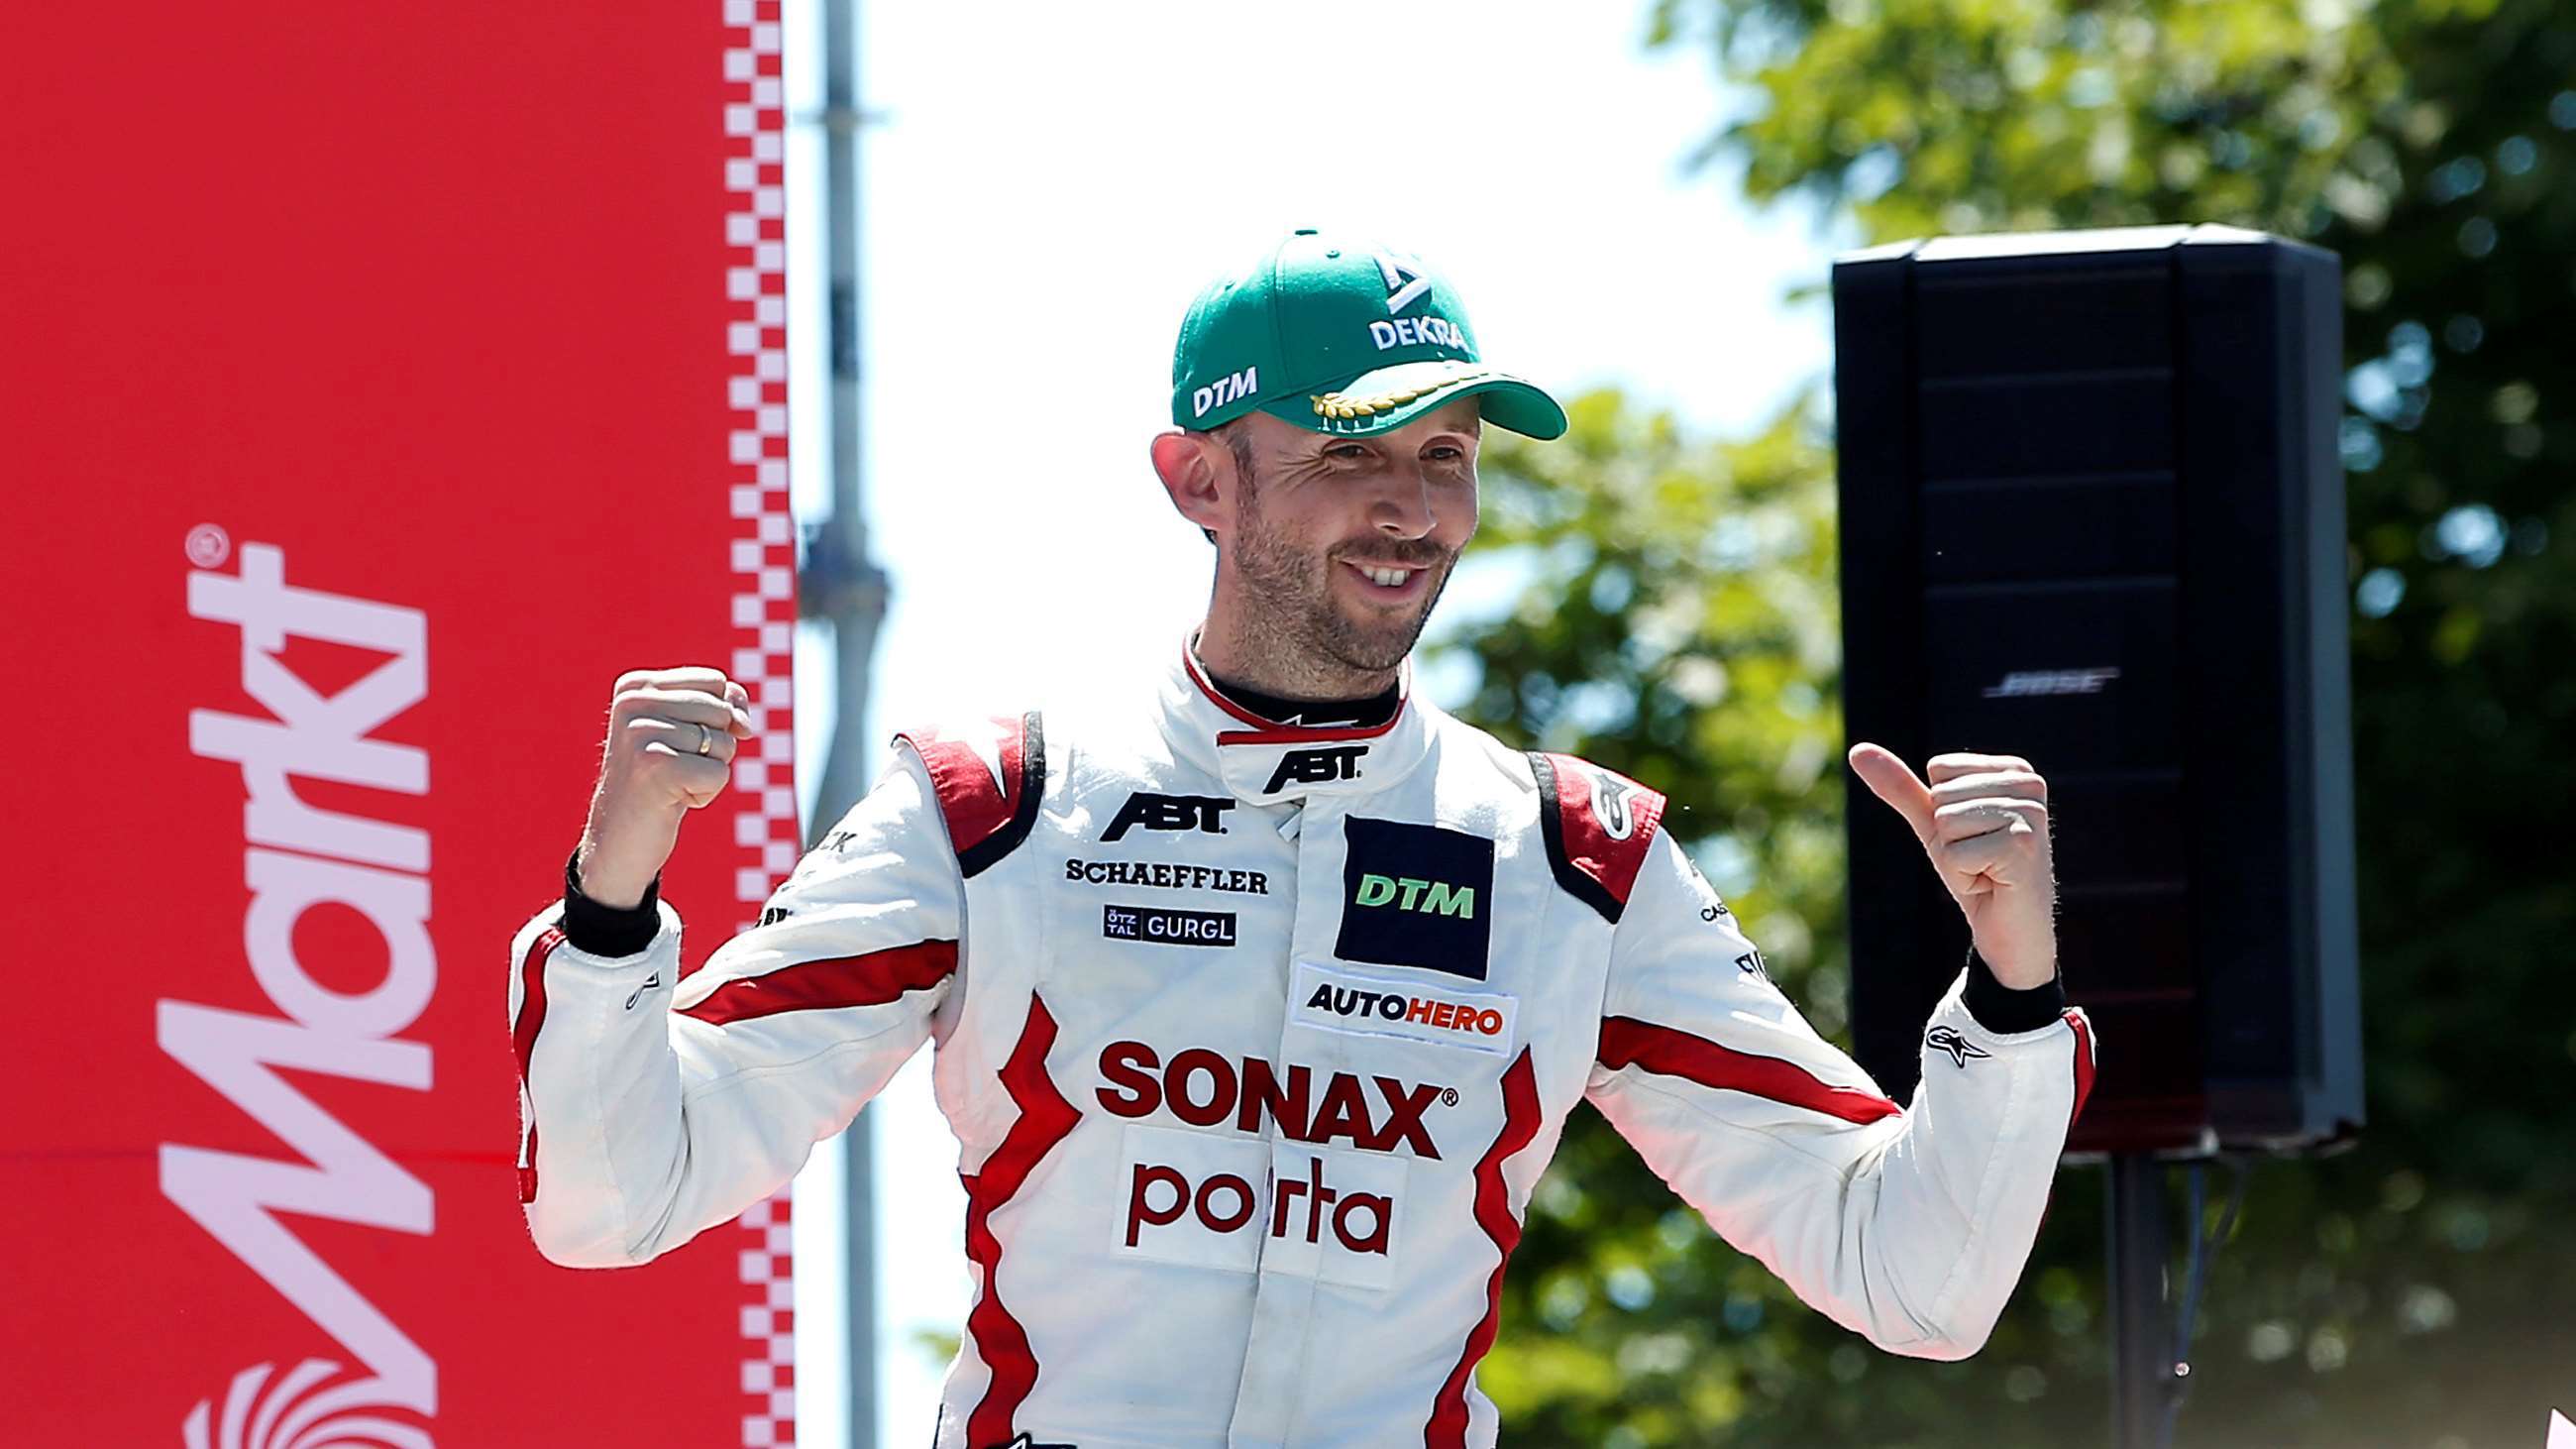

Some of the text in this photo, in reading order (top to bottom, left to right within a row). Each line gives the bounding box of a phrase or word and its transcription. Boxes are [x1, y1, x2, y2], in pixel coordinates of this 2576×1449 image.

[1368, 315, 1471, 351] DEKRA
[1192, 366, 1259, 418] DTM
[1065, 858, 1269, 896] SCHAEFFLER
[1354, 873, 1475, 920] DTM
[1107, 909, 1136, 925] ÖTZ
[1107, 923, 1136, 937] TAL
[1147, 916, 1234, 941] GURGL
[1306, 982, 1504, 1036] AUTOHERO
[1125, 1157, 1394, 1257] porta
